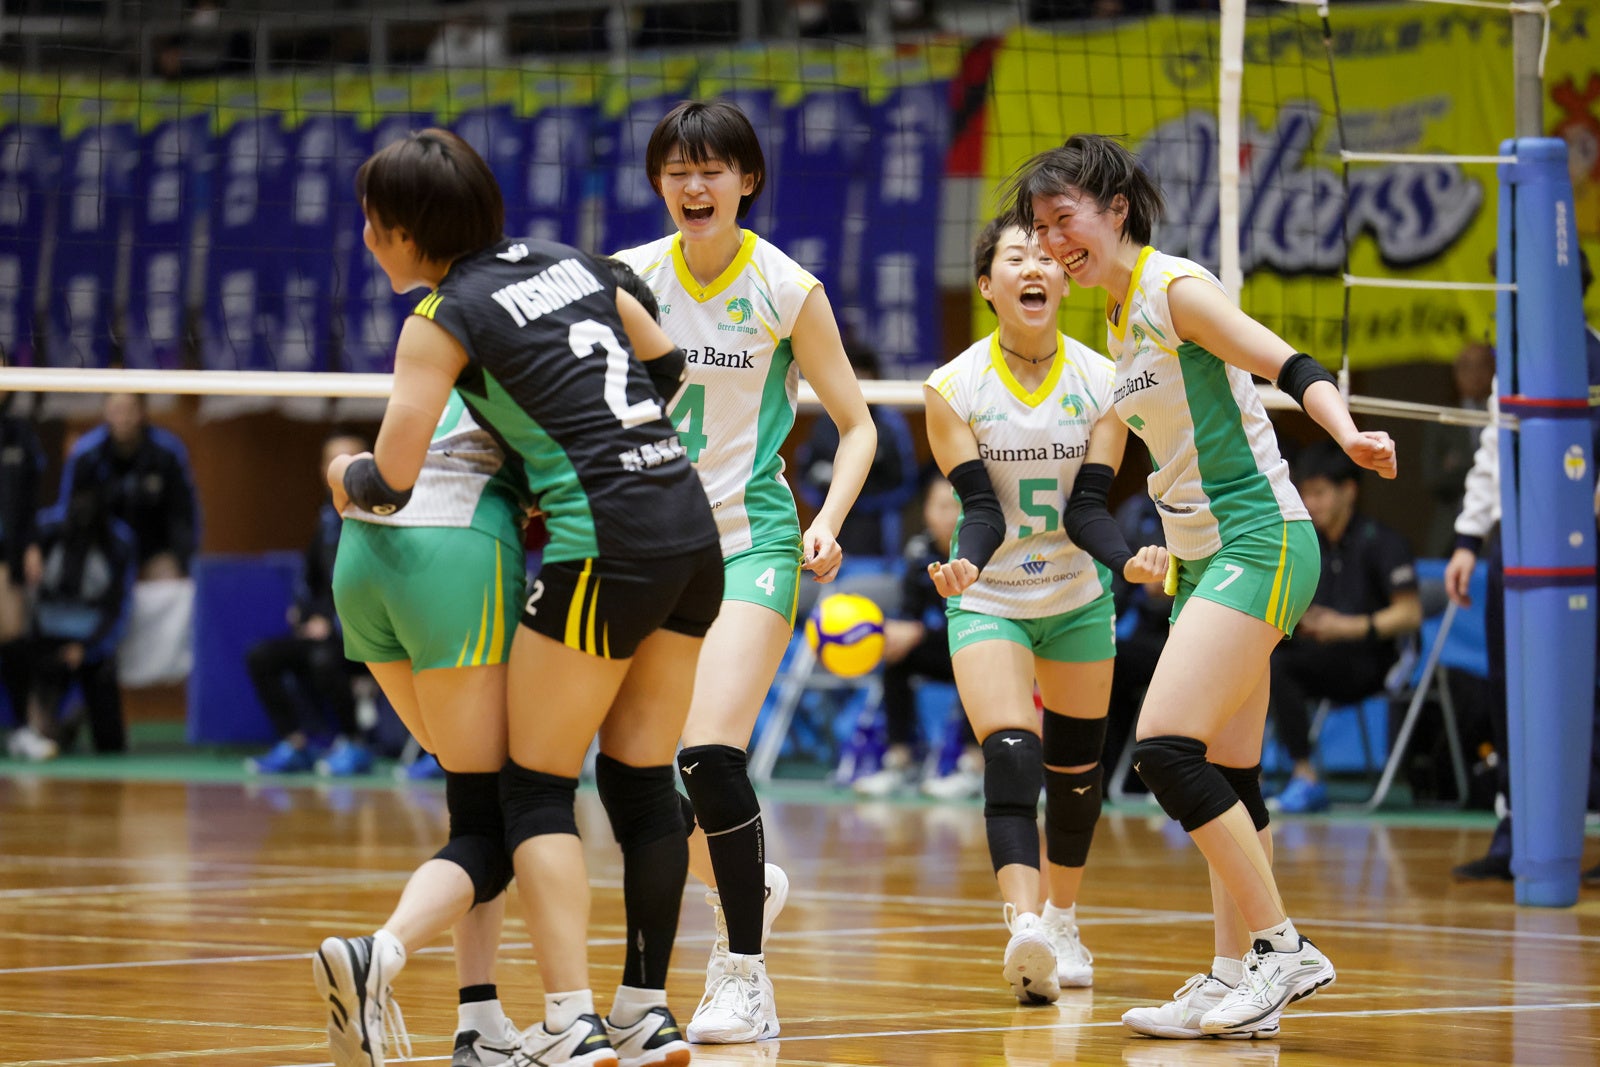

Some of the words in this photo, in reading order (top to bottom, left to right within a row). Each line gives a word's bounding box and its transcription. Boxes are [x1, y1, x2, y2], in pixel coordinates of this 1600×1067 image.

[717, 322, 736, 332] Green
[702, 346, 755, 369] Bank
[568, 318, 662, 430] 2
[1126, 370, 1159, 397] Bank
[668, 383, 708, 463] 4
[978, 443, 1048, 462] Gunma
[1018, 478, 1059, 540] 5
[755, 567, 776, 596] 4
[1213, 563, 1245, 592] 7
[525, 579, 545, 616] 2
